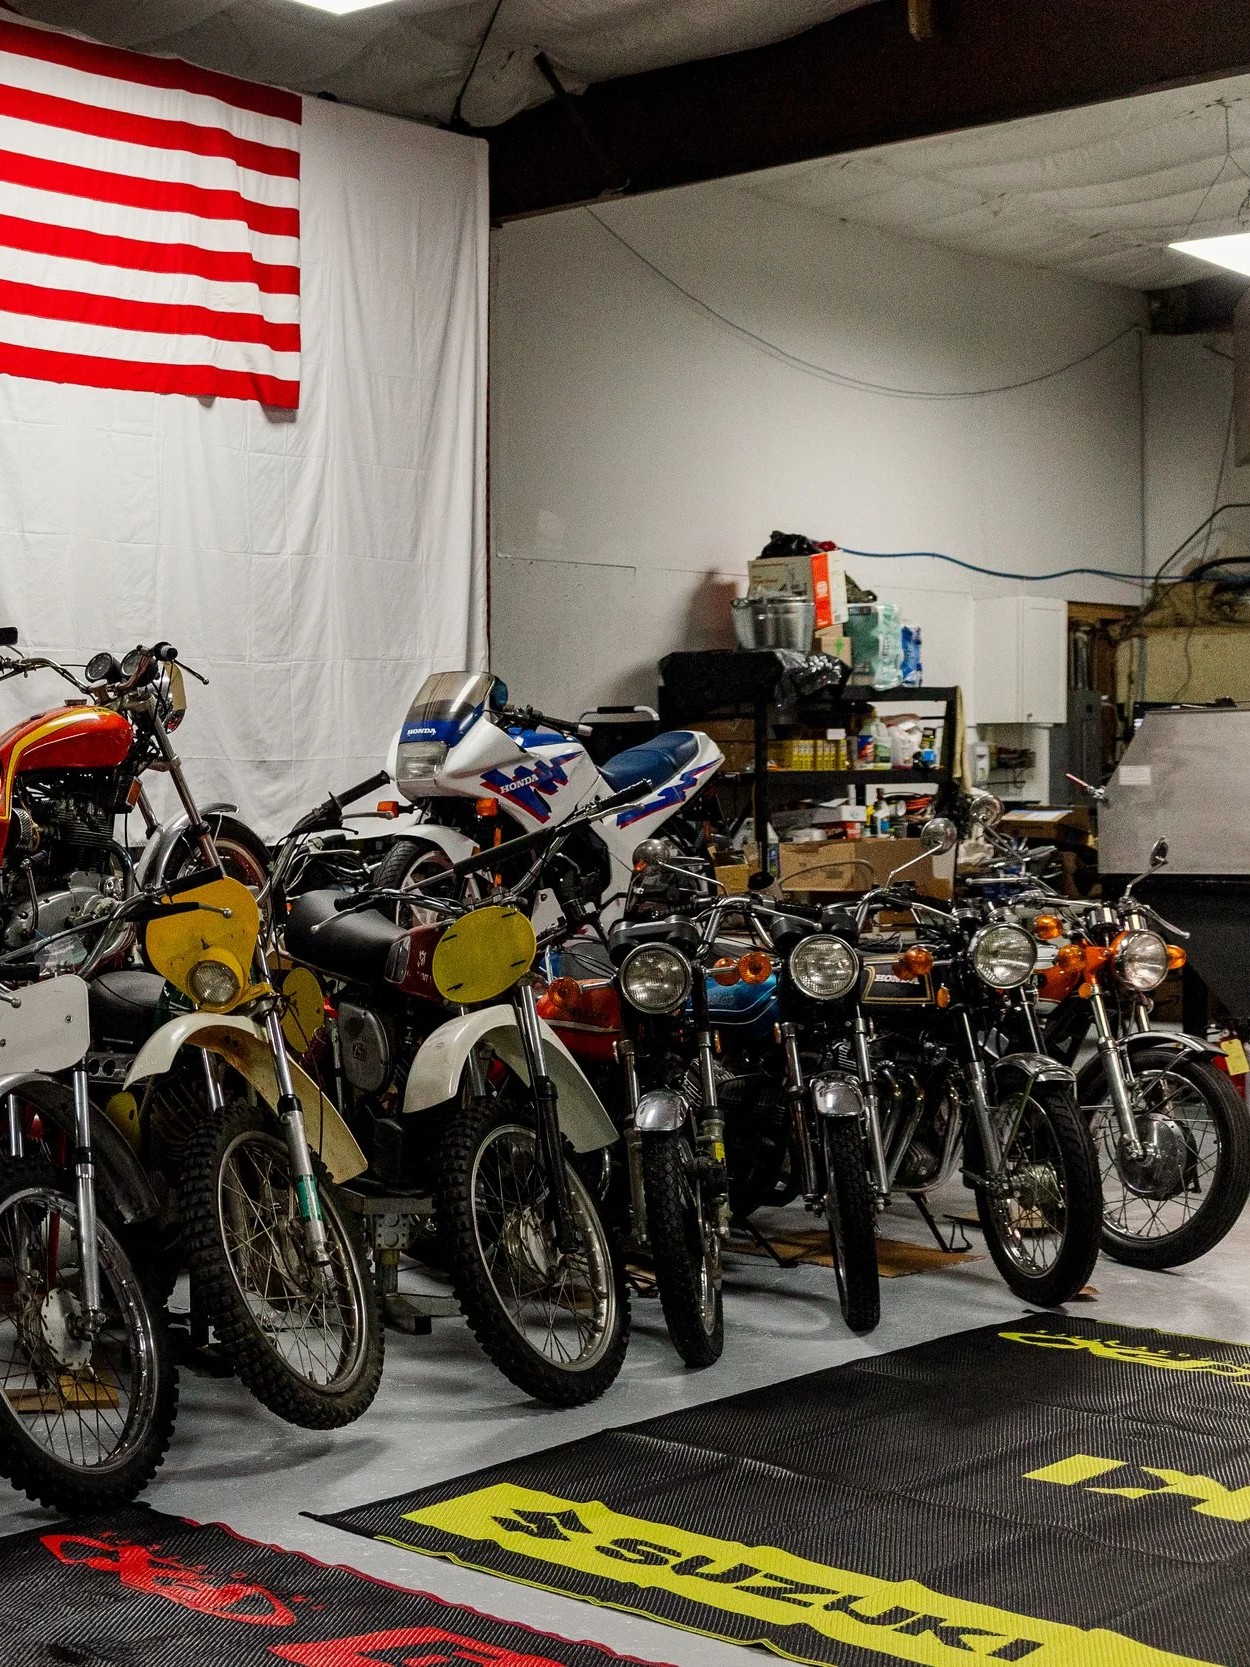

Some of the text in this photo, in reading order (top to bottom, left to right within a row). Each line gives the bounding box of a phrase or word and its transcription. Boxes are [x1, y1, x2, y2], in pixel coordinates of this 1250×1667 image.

[407, 728, 437, 736] HONDA
[500, 774, 539, 794] HONDA
[595, 1538, 1044, 1662] SUZUKI
